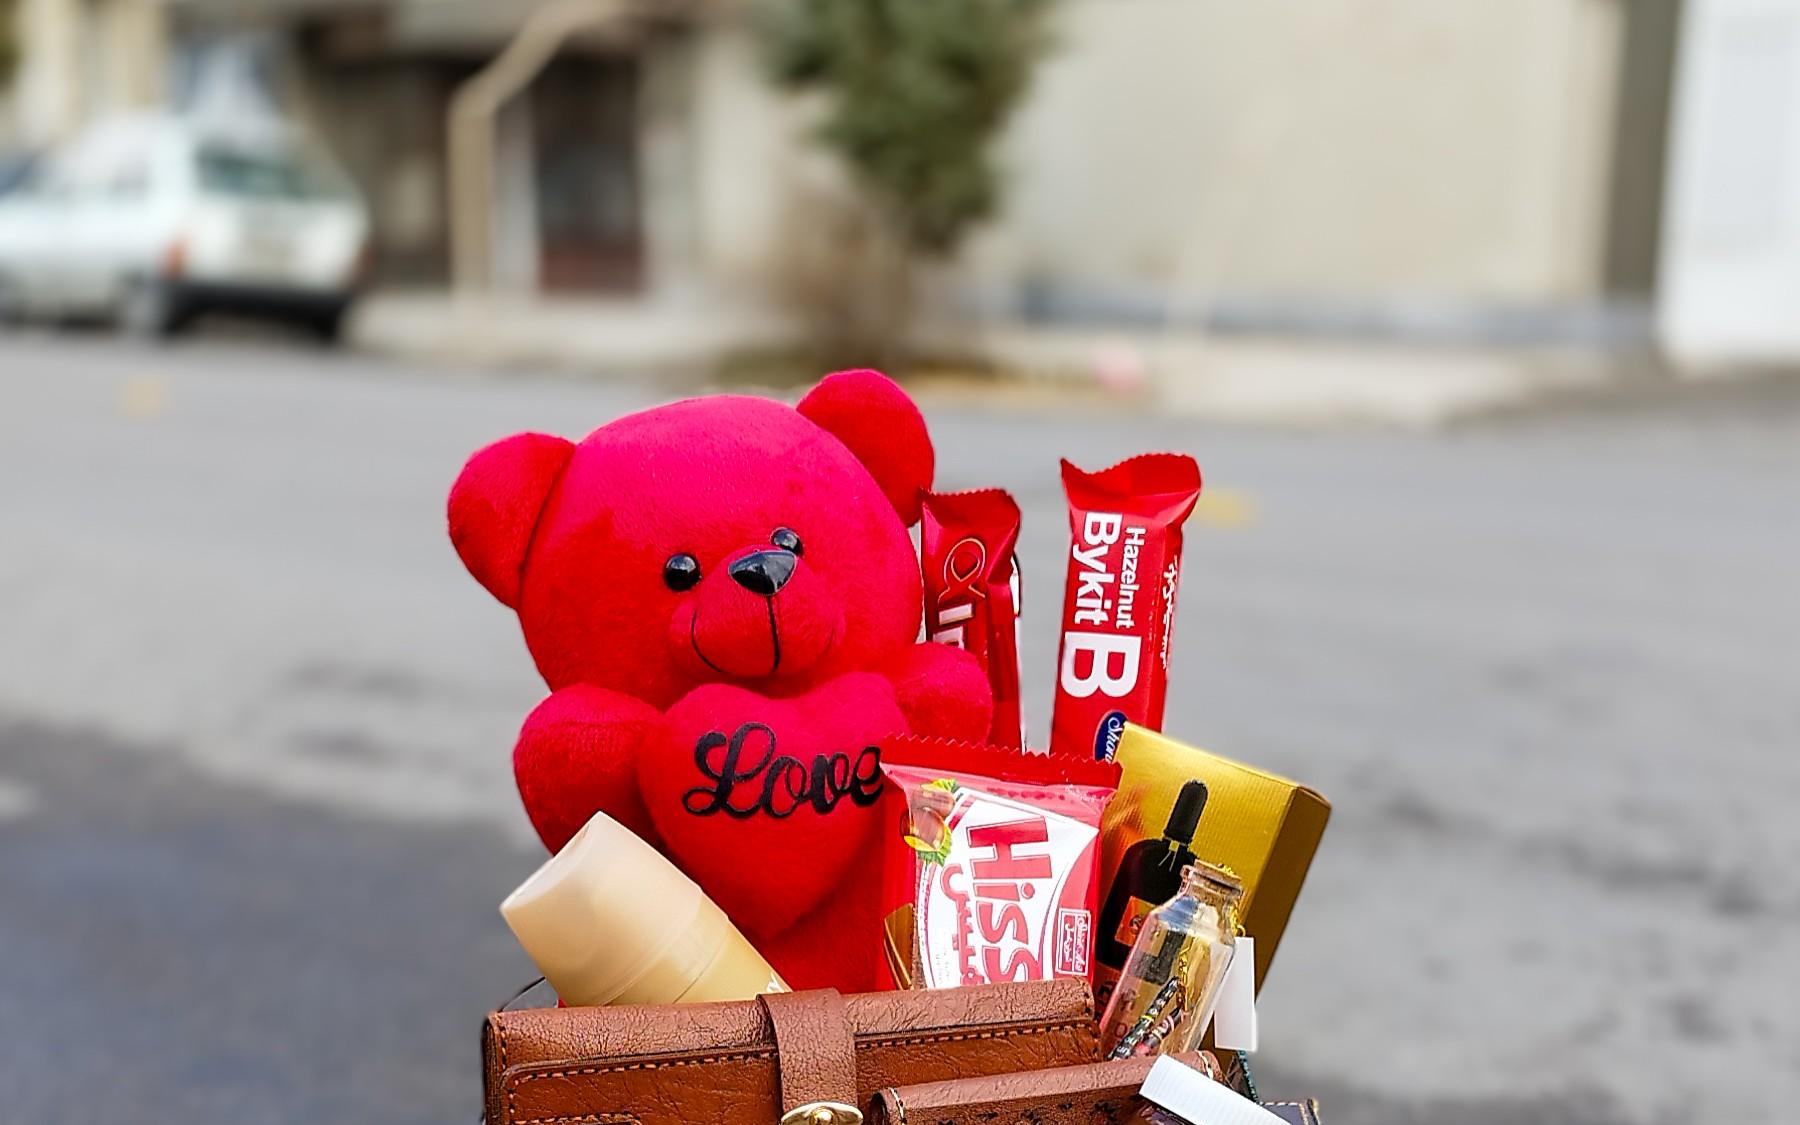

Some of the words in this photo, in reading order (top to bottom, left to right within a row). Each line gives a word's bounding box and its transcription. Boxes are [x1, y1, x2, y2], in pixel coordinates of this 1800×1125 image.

[1072, 511, 1123, 626] Bykit
[1116, 525, 1147, 629] Hazelnut
[1060, 631, 1142, 698] B
[682, 721, 884, 819] Love
[966, 815, 1052, 984] Hiss
